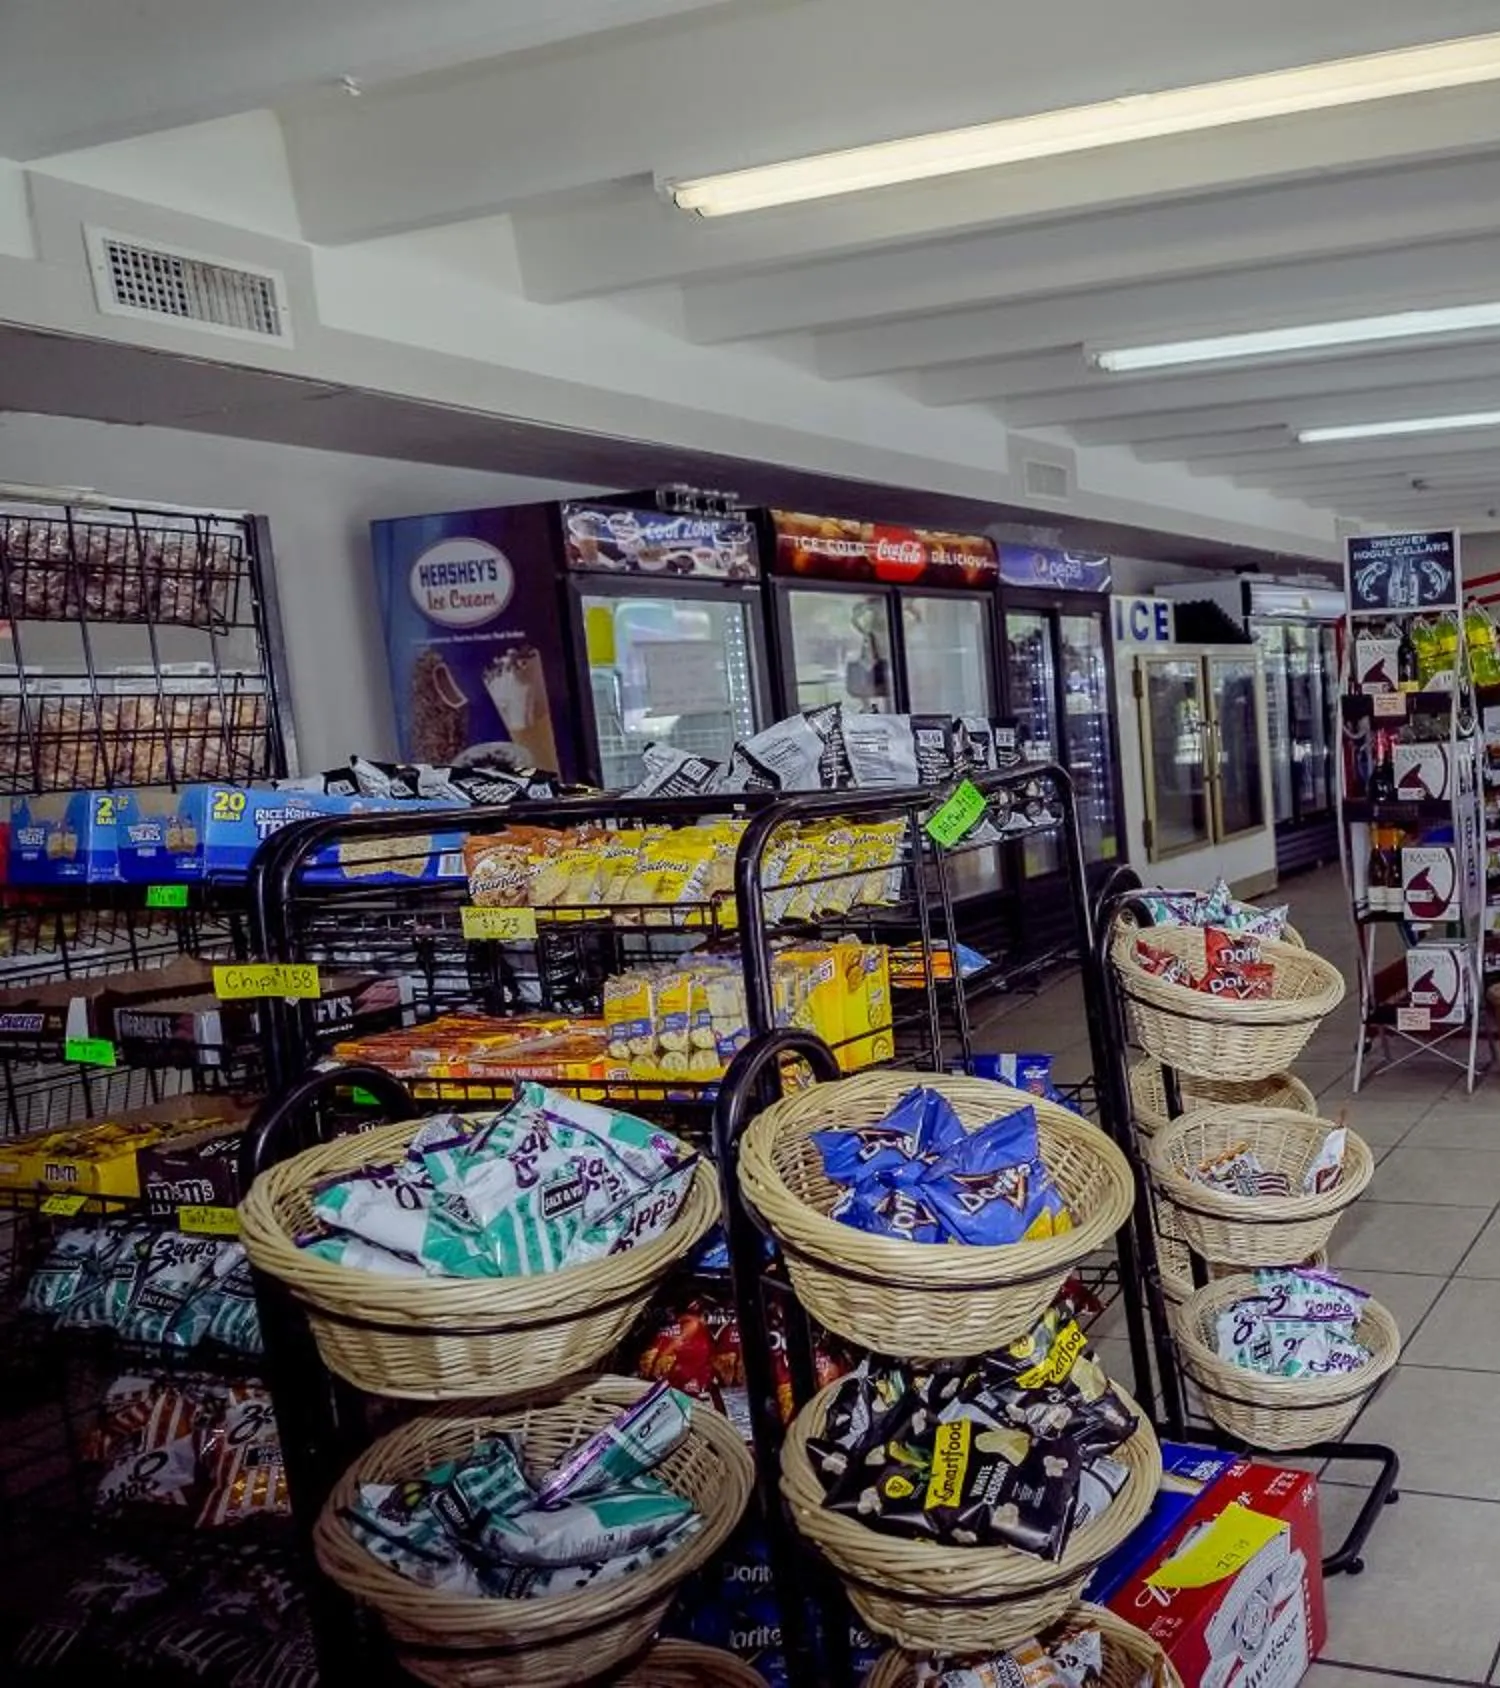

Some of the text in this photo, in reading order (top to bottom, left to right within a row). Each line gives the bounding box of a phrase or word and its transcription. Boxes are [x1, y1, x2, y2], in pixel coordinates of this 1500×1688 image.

[419, 559, 498, 588] HERSHEY'S
[427, 589, 497, 610] Ice Cream
[1116, 600, 1169, 641] ICE
[213, 790, 246, 812] 20
[255, 809, 285, 819] RICE
[969, 1465, 994, 1498] WHITE
